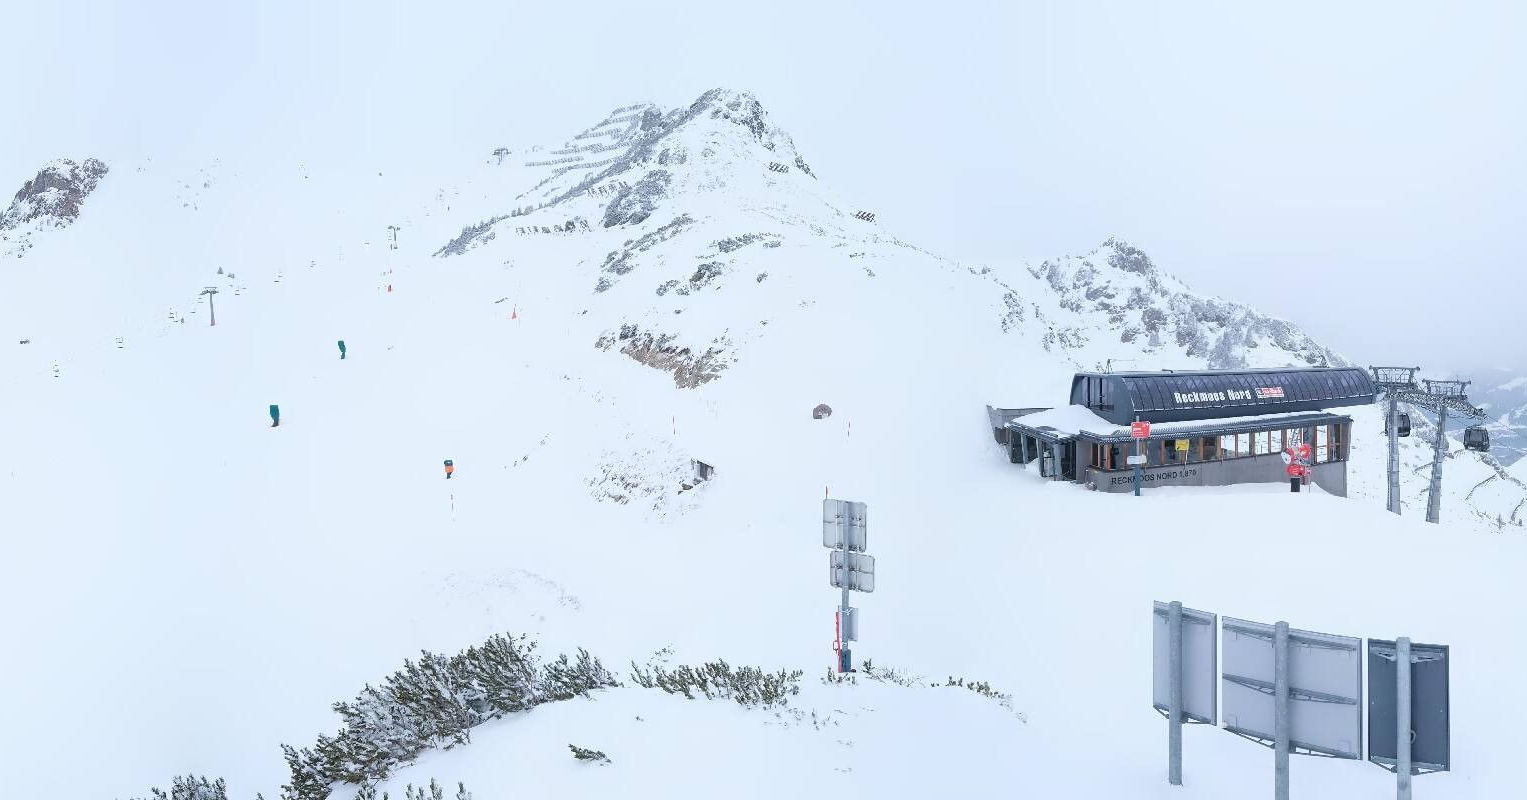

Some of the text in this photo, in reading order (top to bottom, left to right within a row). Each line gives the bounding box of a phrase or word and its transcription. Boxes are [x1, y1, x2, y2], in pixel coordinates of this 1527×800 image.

[1174, 391, 1226, 403] Reckmoos
[1227, 389, 1251, 401] Nord
[1111, 474, 1155, 485] RECKOOS
[1156, 471, 1178, 481] NORD
